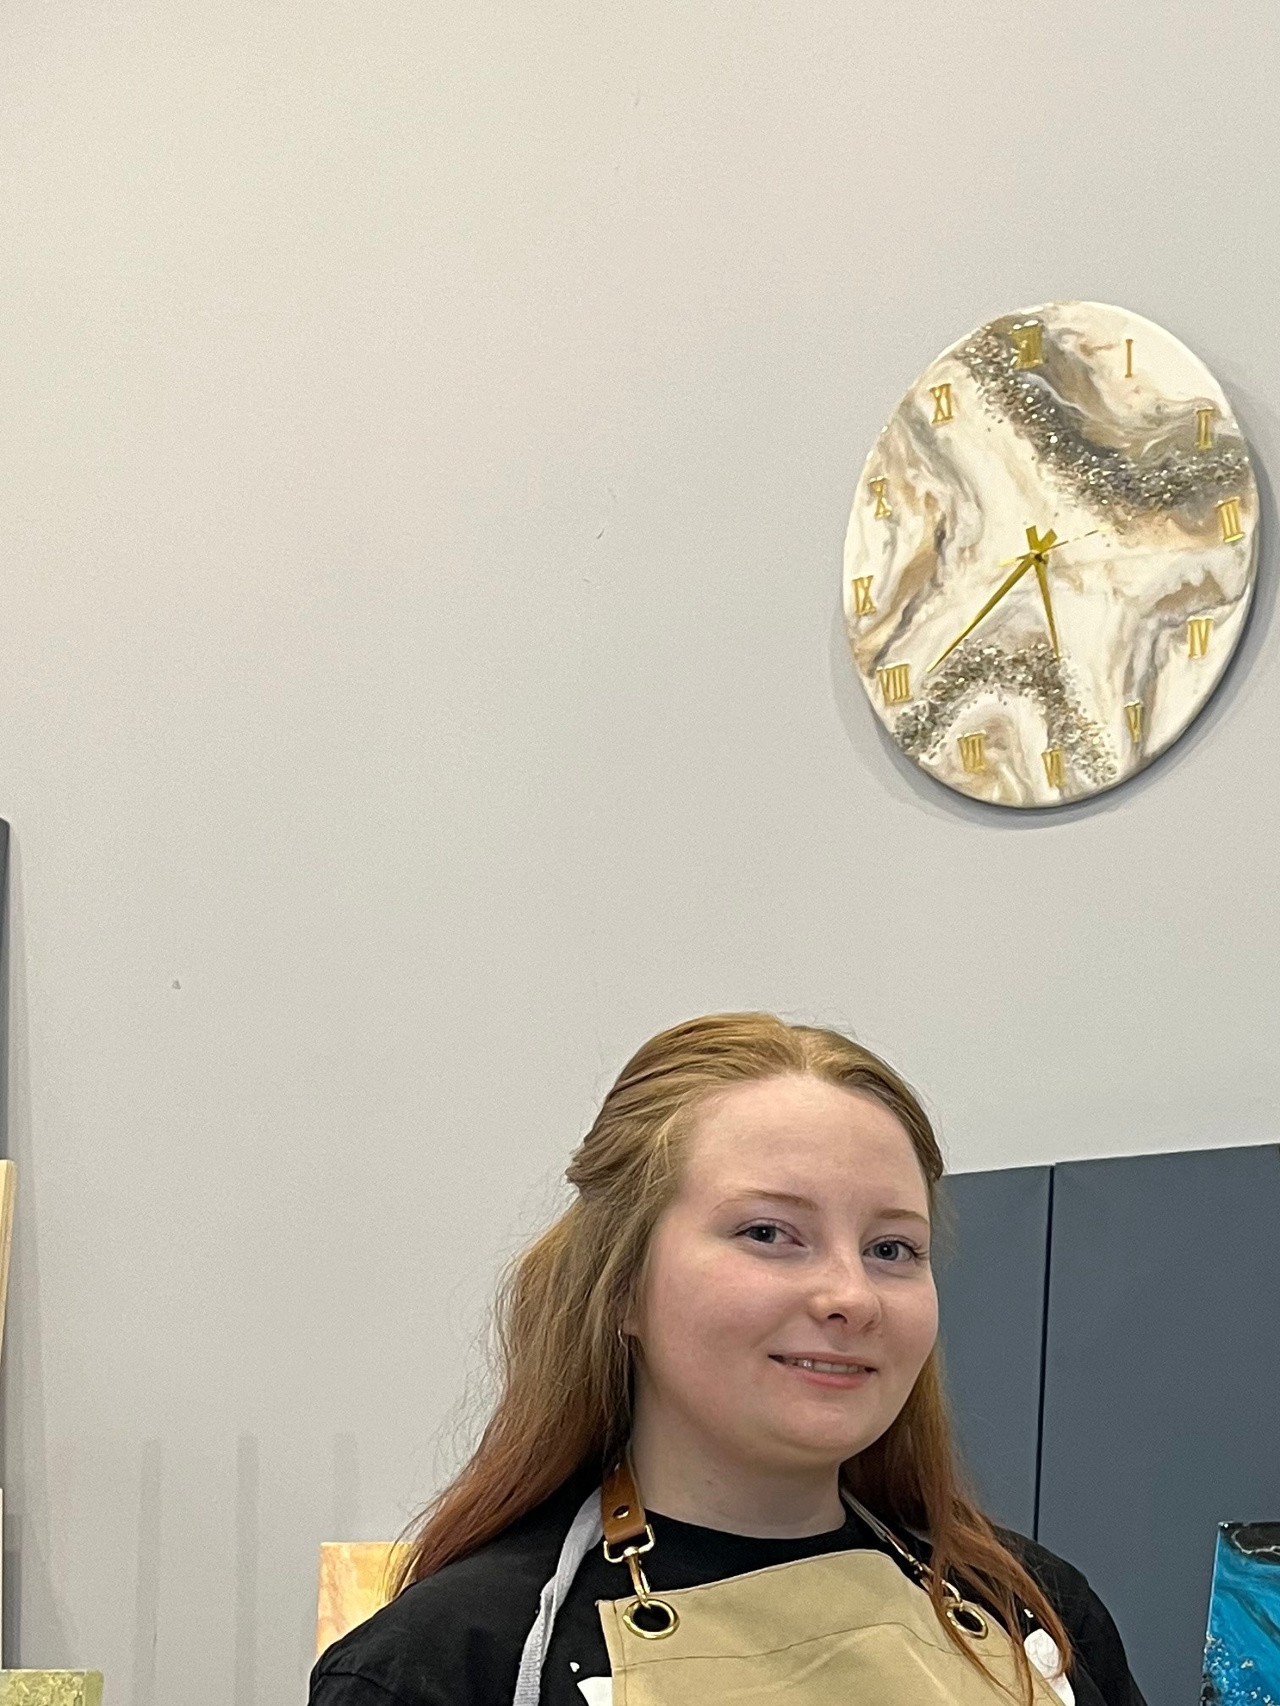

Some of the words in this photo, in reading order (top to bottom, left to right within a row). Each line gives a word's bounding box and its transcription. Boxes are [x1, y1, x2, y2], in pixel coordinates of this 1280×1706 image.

[1125, 338, 1133, 378] I
[929, 382, 954, 424] XI
[869, 477, 892, 519] X
[1215, 497, 1245, 543] III
[852, 575, 877, 616] IX
[1188, 617, 1214, 659] IV
[877, 663, 913, 704] VIII
[1124, 701, 1142, 743] V
[1041, 749, 1066, 787] VI
